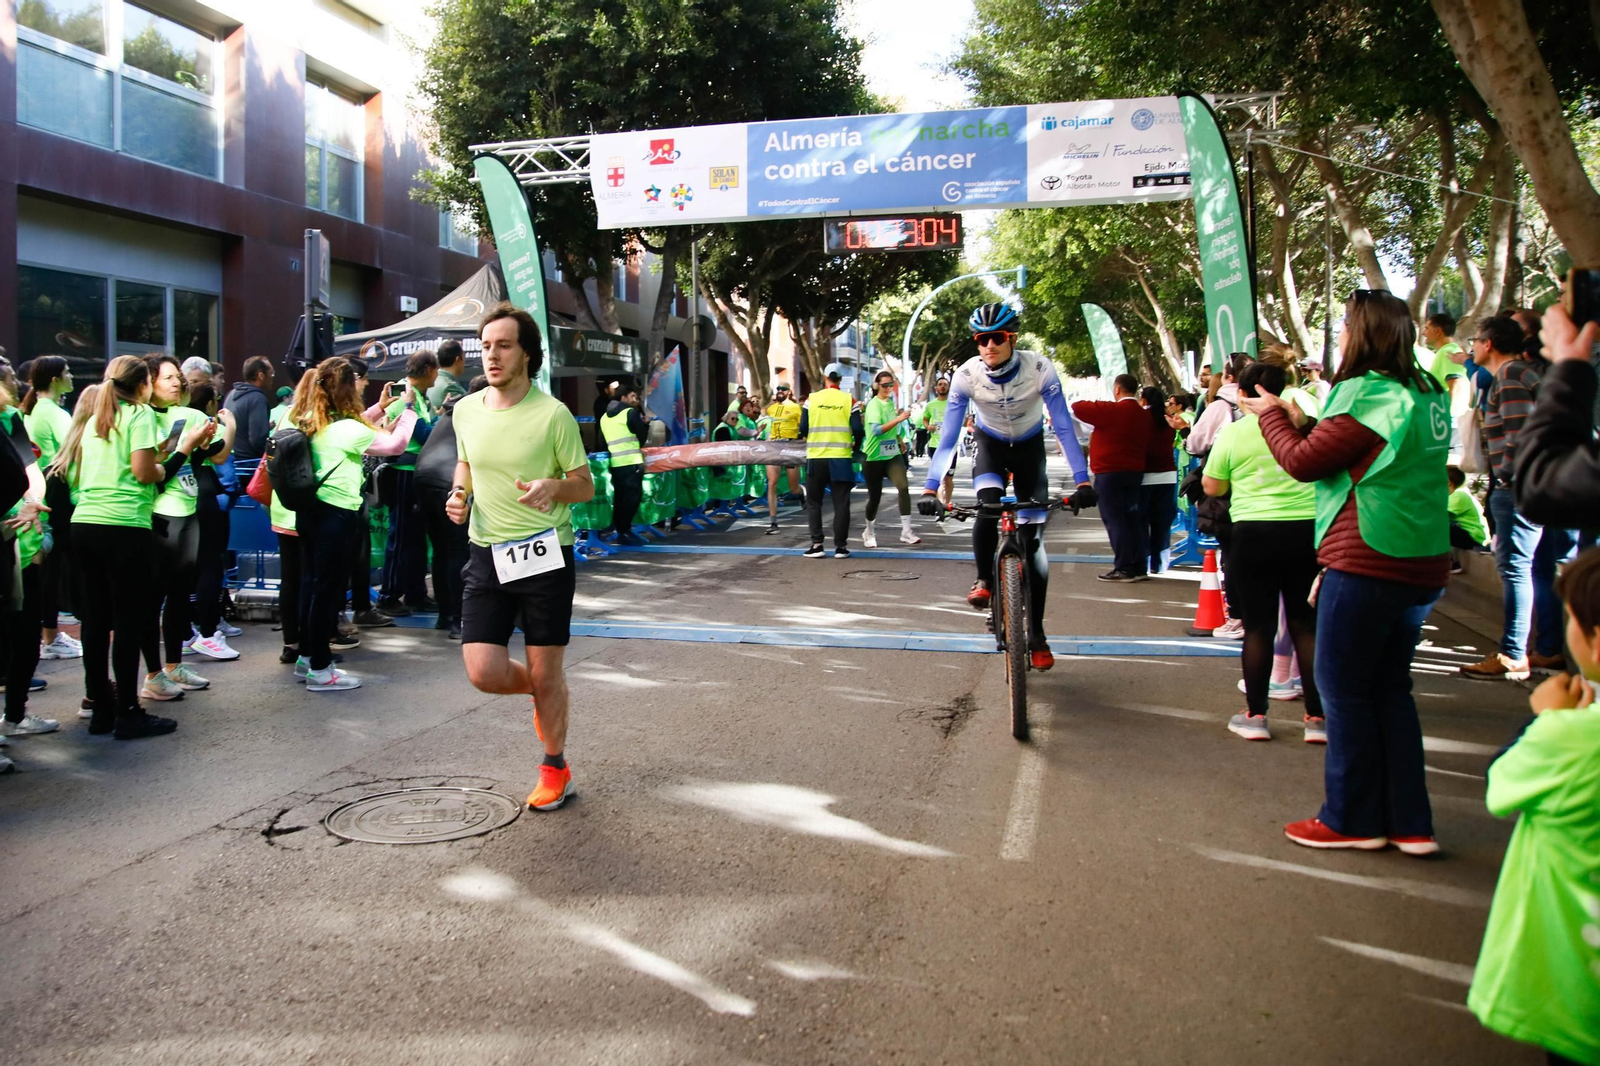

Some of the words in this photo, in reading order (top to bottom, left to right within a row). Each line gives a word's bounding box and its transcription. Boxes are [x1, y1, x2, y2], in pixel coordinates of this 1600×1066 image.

[1061, 116, 1114, 129] cajamar
[764, 126, 862, 152] Almería
[1113, 144, 1174, 157] Fundación
[764, 157, 846, 180] contra
[853, 153, 878, 175] el
[885, 151, 977, 173] cáncer
[1144, 162, 1166, 173] Ejido
[1066, 174, 1093, 182] Toyota
[1066, 181, 1096, 190] Alborán
[1097, 180, 1121, 188] Motor
[390, 337, 449, 355] cruzand
[506, 540, 547, 564] 176
